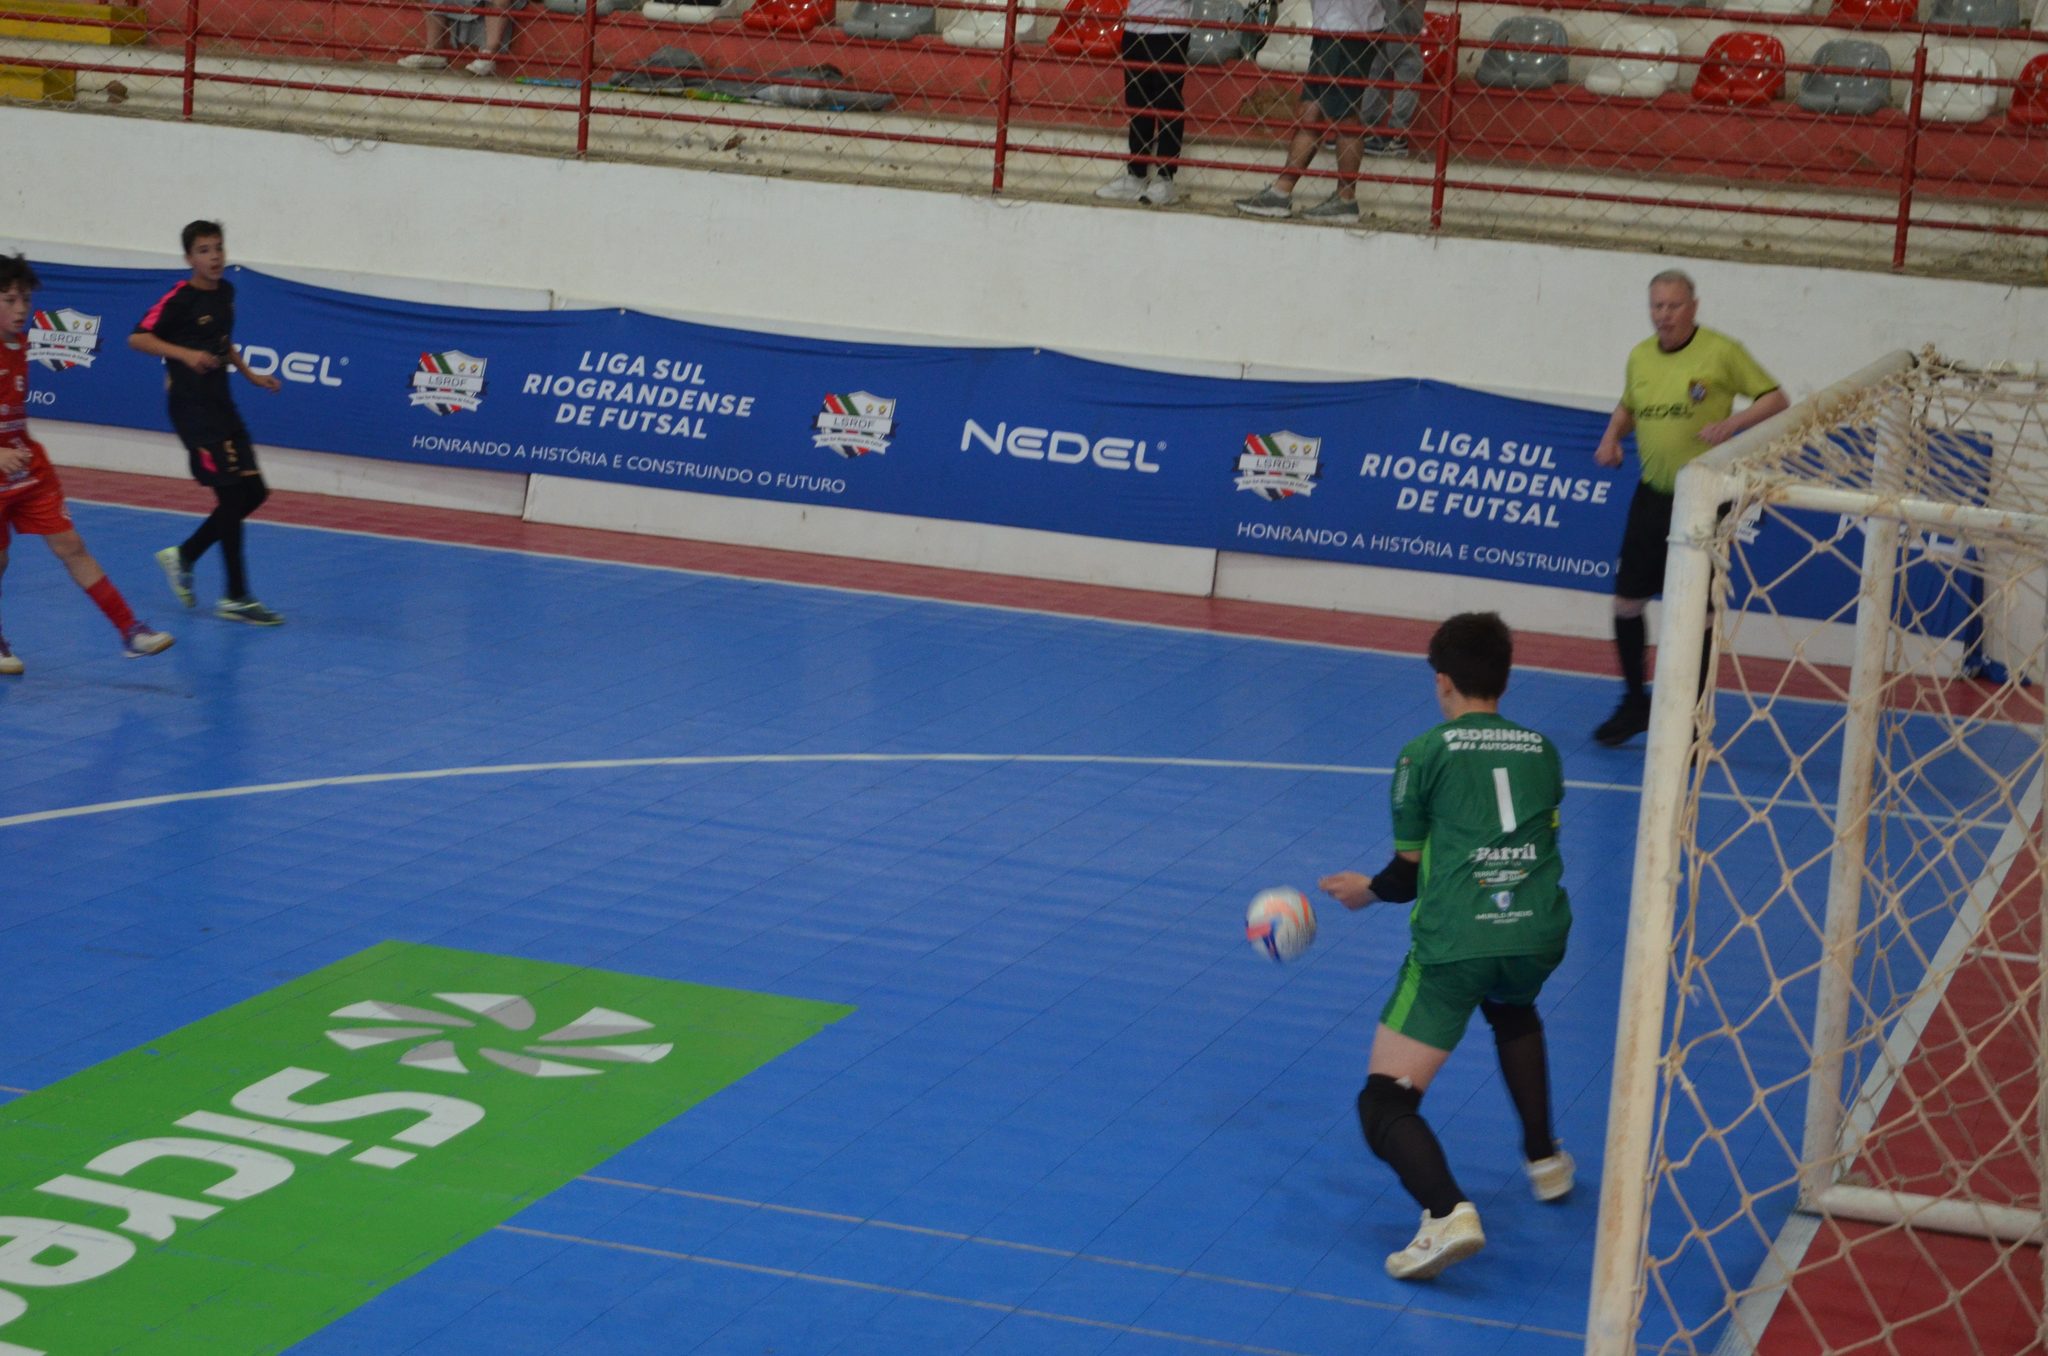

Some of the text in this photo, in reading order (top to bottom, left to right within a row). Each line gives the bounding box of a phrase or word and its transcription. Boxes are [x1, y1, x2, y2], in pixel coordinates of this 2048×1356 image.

[578, 350, 706, 385] LIGA SUL
[522, 373, 756, 417] RIOGRANDENSE
[555, 402, 708, 439] DE FUTSAL
[412, 435, 846, 494] HONRANDO A HISTÓRIA E CONSTRUINDO O FUTURO
[1419, 427, 1557, 470] LIGA SUL
[1360, 453, 1612, 505] RIOGRANDENSE
[1396, 486, 1561, 529] DE FUTSAL
[1236, 521, 1348, 548] HONRANDO
[1352, 534, 1365, 549] A
[1370, 535, 1453, 559] HISTÓRIA
[1459, 545, 1468, 560] E
[1473, 546, 1610, 578] CONSTRUINDO
[1443, 728, 1543, 743] PEDRINHO
[1492, 767, 1517, 832] 1
[0, 1066, 486, 1356] Sicre
